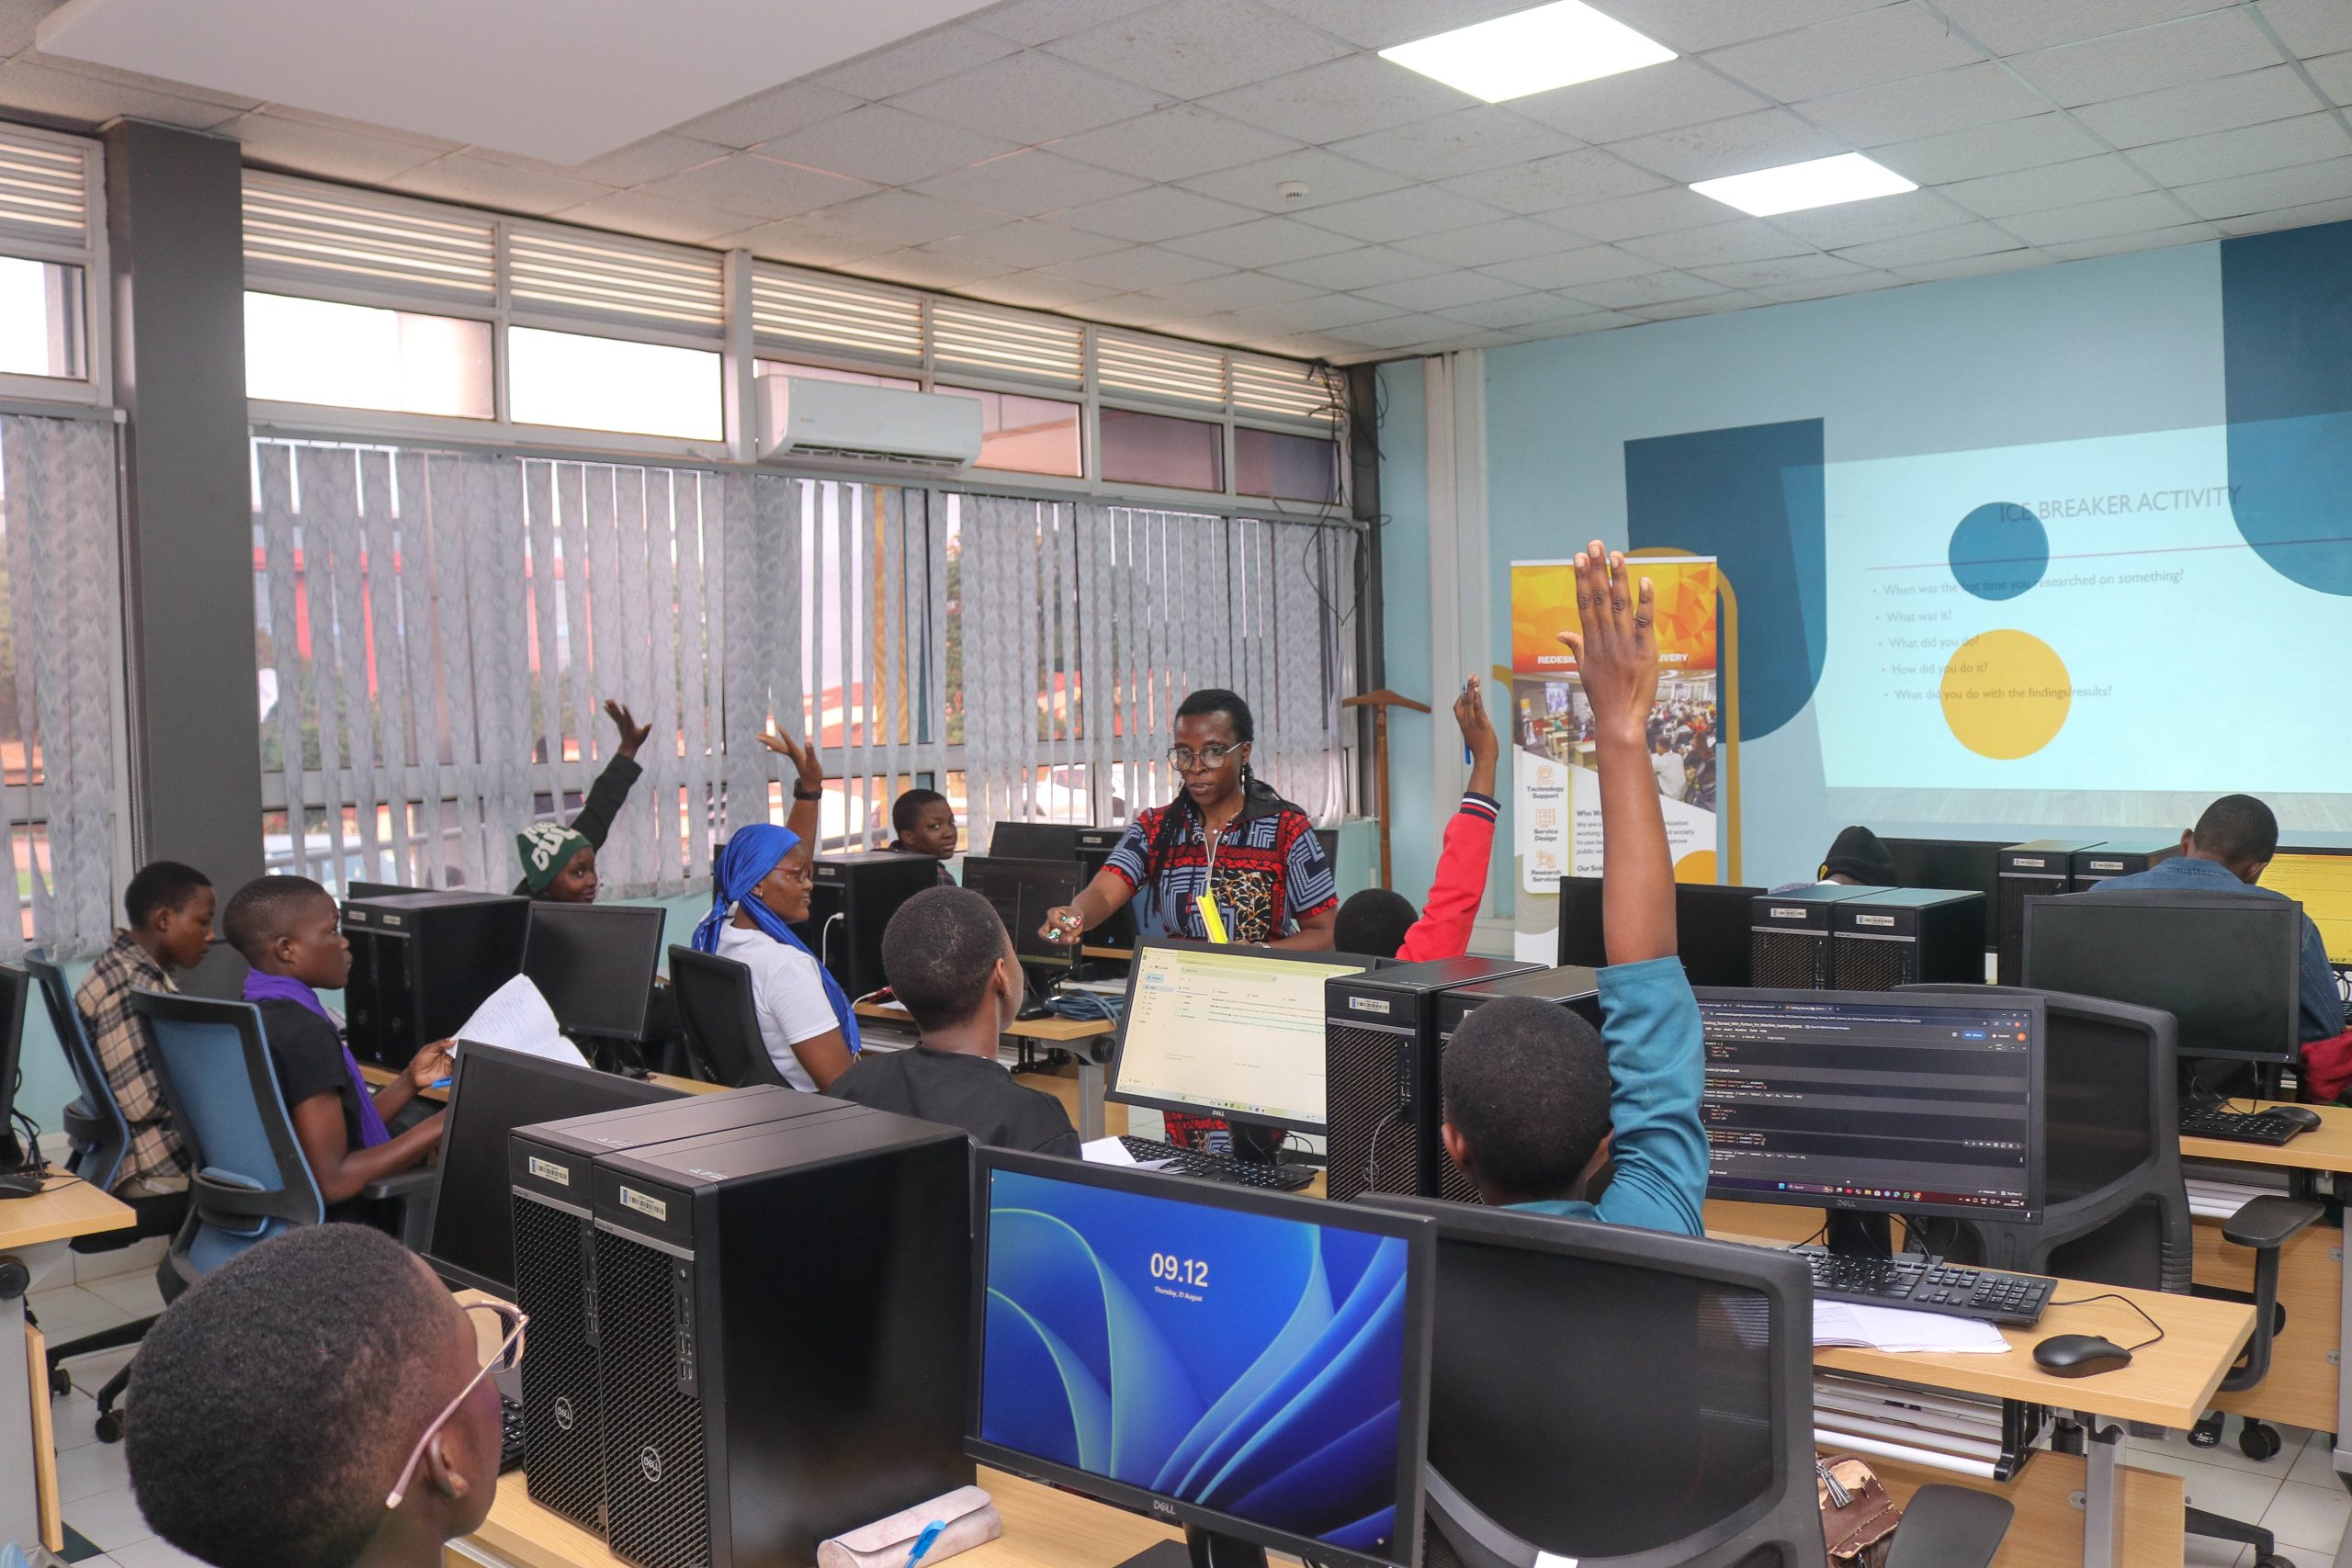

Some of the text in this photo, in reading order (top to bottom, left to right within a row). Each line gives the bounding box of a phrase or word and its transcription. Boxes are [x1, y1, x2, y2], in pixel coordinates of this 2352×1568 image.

[1999, 484, 2243, 523] ICE BREAKER ACTIVITY
[1883, 568, 2185, 596] When was the last time you researched on something?
[1885, 609, 1952, 622] What was it?
[1889, 635, 1980, 650] What did you do?
[1658, 652, 1689, 661] IVERY
[1892, 661, 1988, 677] How did you do it?
[1894, 684, 2112, 702] What did you do with the findings/results?
[1838, 1199, 1856, 1208] DELL
[1150, 1252, 1209, 1288] 09.12
[1154, 1286, 1177, 1298] Thursday,
[1184, 1292, 1204, 1303] August
[1153, 1499, 1176, 1515] DELL
